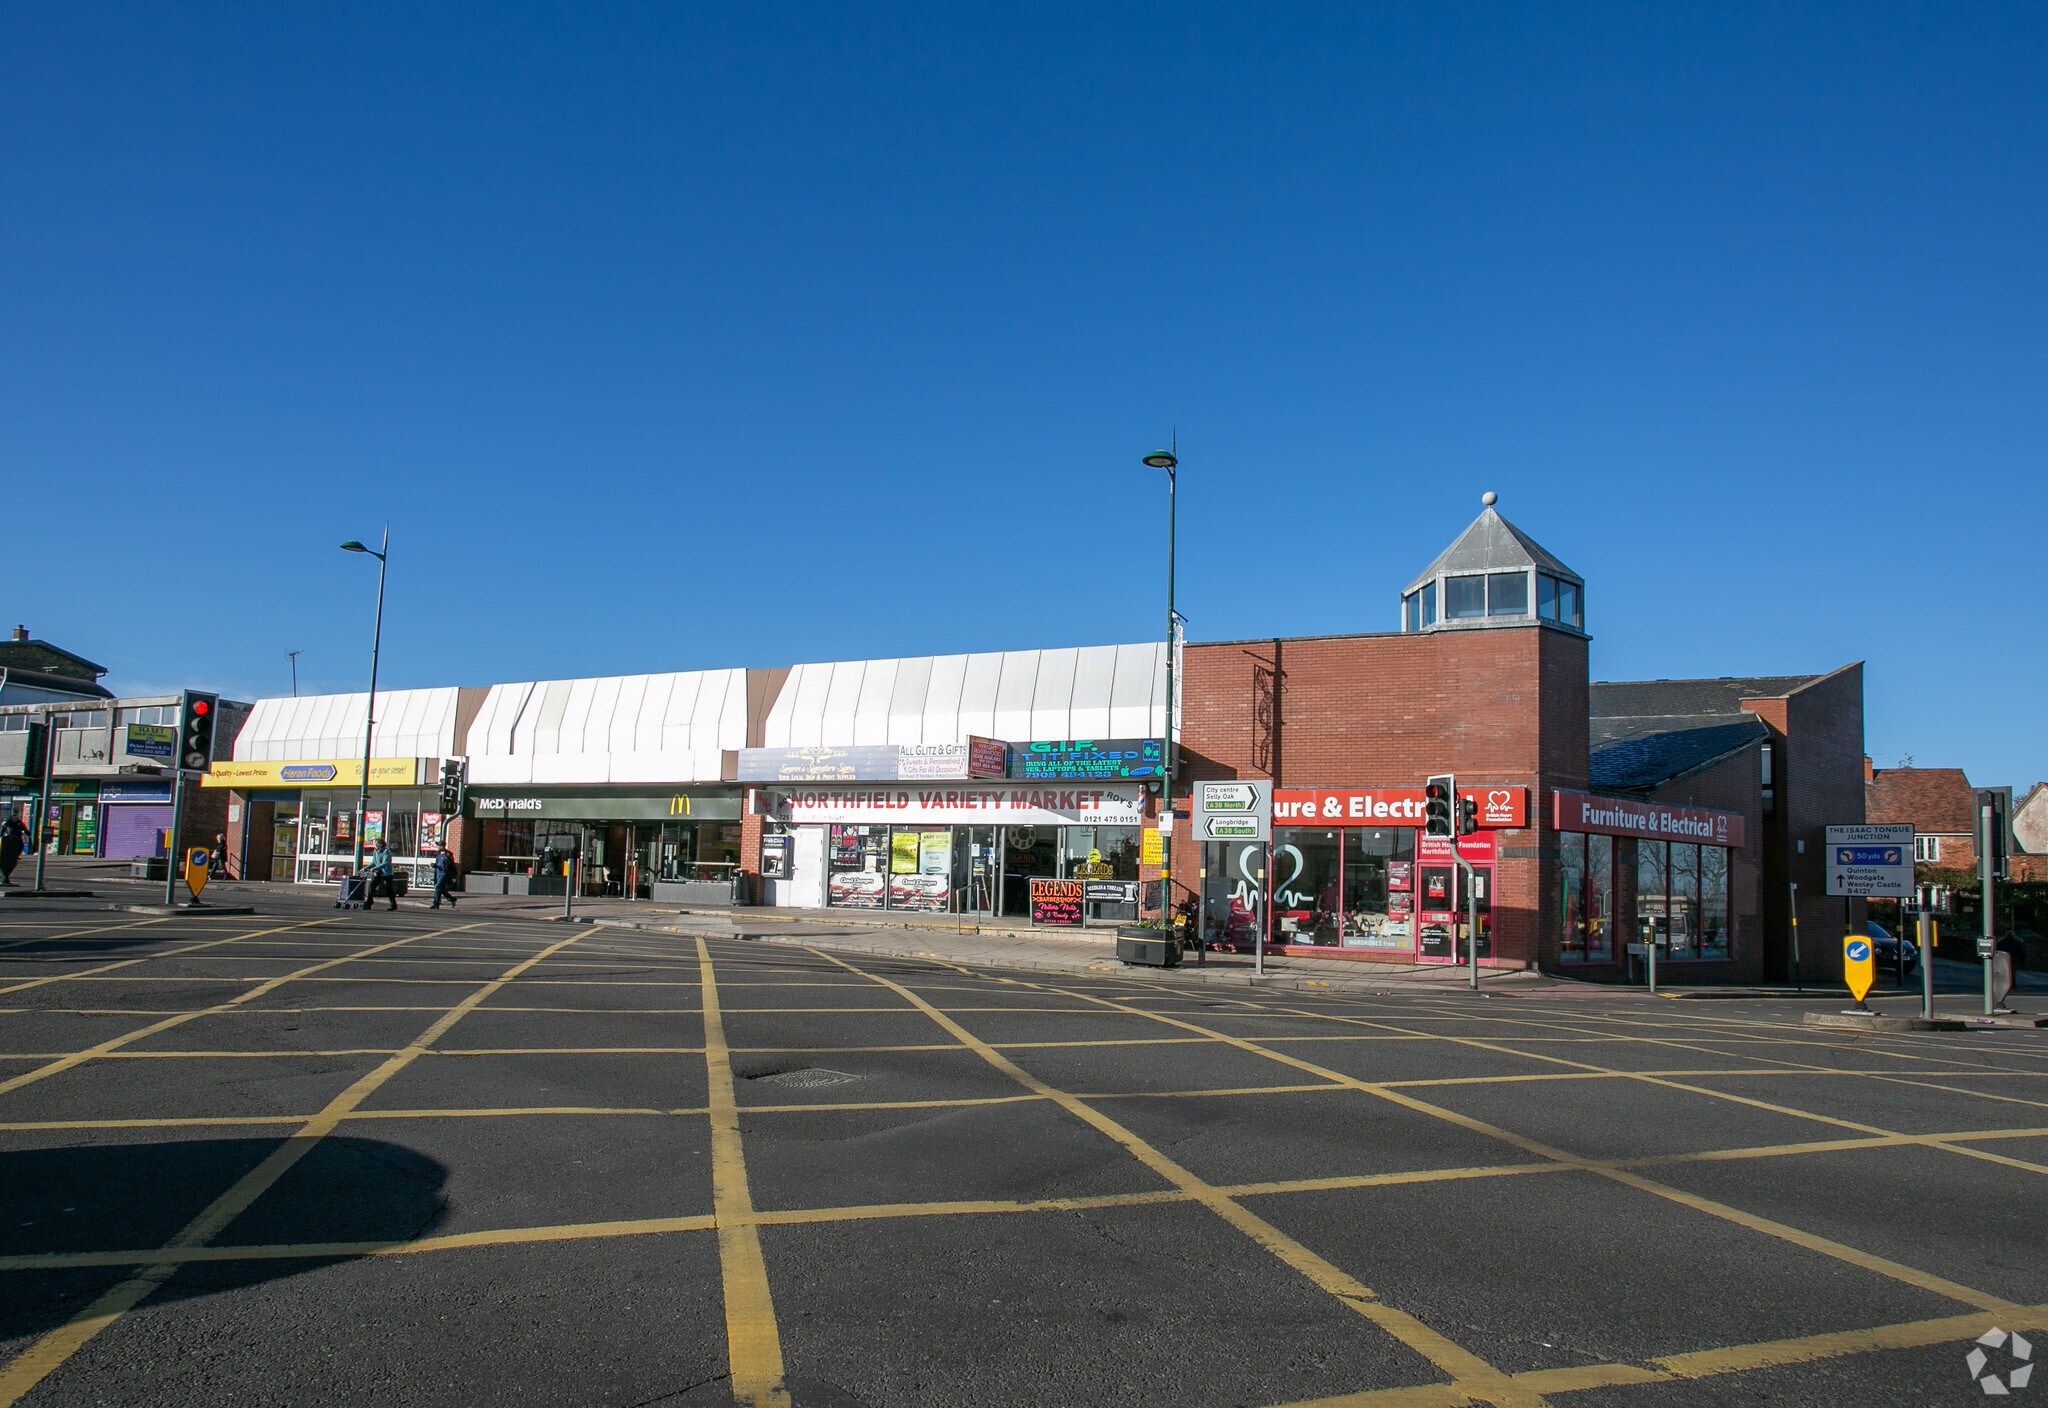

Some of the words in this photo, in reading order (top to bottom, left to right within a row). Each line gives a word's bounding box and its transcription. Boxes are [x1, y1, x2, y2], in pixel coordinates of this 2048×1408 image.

[900, 746, 914, 756] ALL
[916, 744, 936, 756] GLITZ
[938, 744, 944, 755] &
[946, 744, 966, 755] GIFTS
[974, 748, 1002, 756] SILVERWOOD
[1042, 753, 1062, 761] IT
[1069, 751, 1139, 760] FIXED
[216, 770, 232, 778] Quality
[283, 768, 306, 778] Heron
[308, 767, 331, 778] Foods
[480, 798, 542, 810] McDonald's
[792, 791, 909, 809] NORTHFIELD
[918, 790, 1007, 809] VARIETY
[1011, 790, 1104, 810] MARKET
[1106, 791, 1133, 809] ROY'S
[1322, 796, 1342, 818] &
[1582, 802, 1646, 830] Furniture
[1649, 811, 1658, 832] &
[1660, 812, 1713, 837] Electrical
[1032, 880, 1082, 896] LEGENDS
